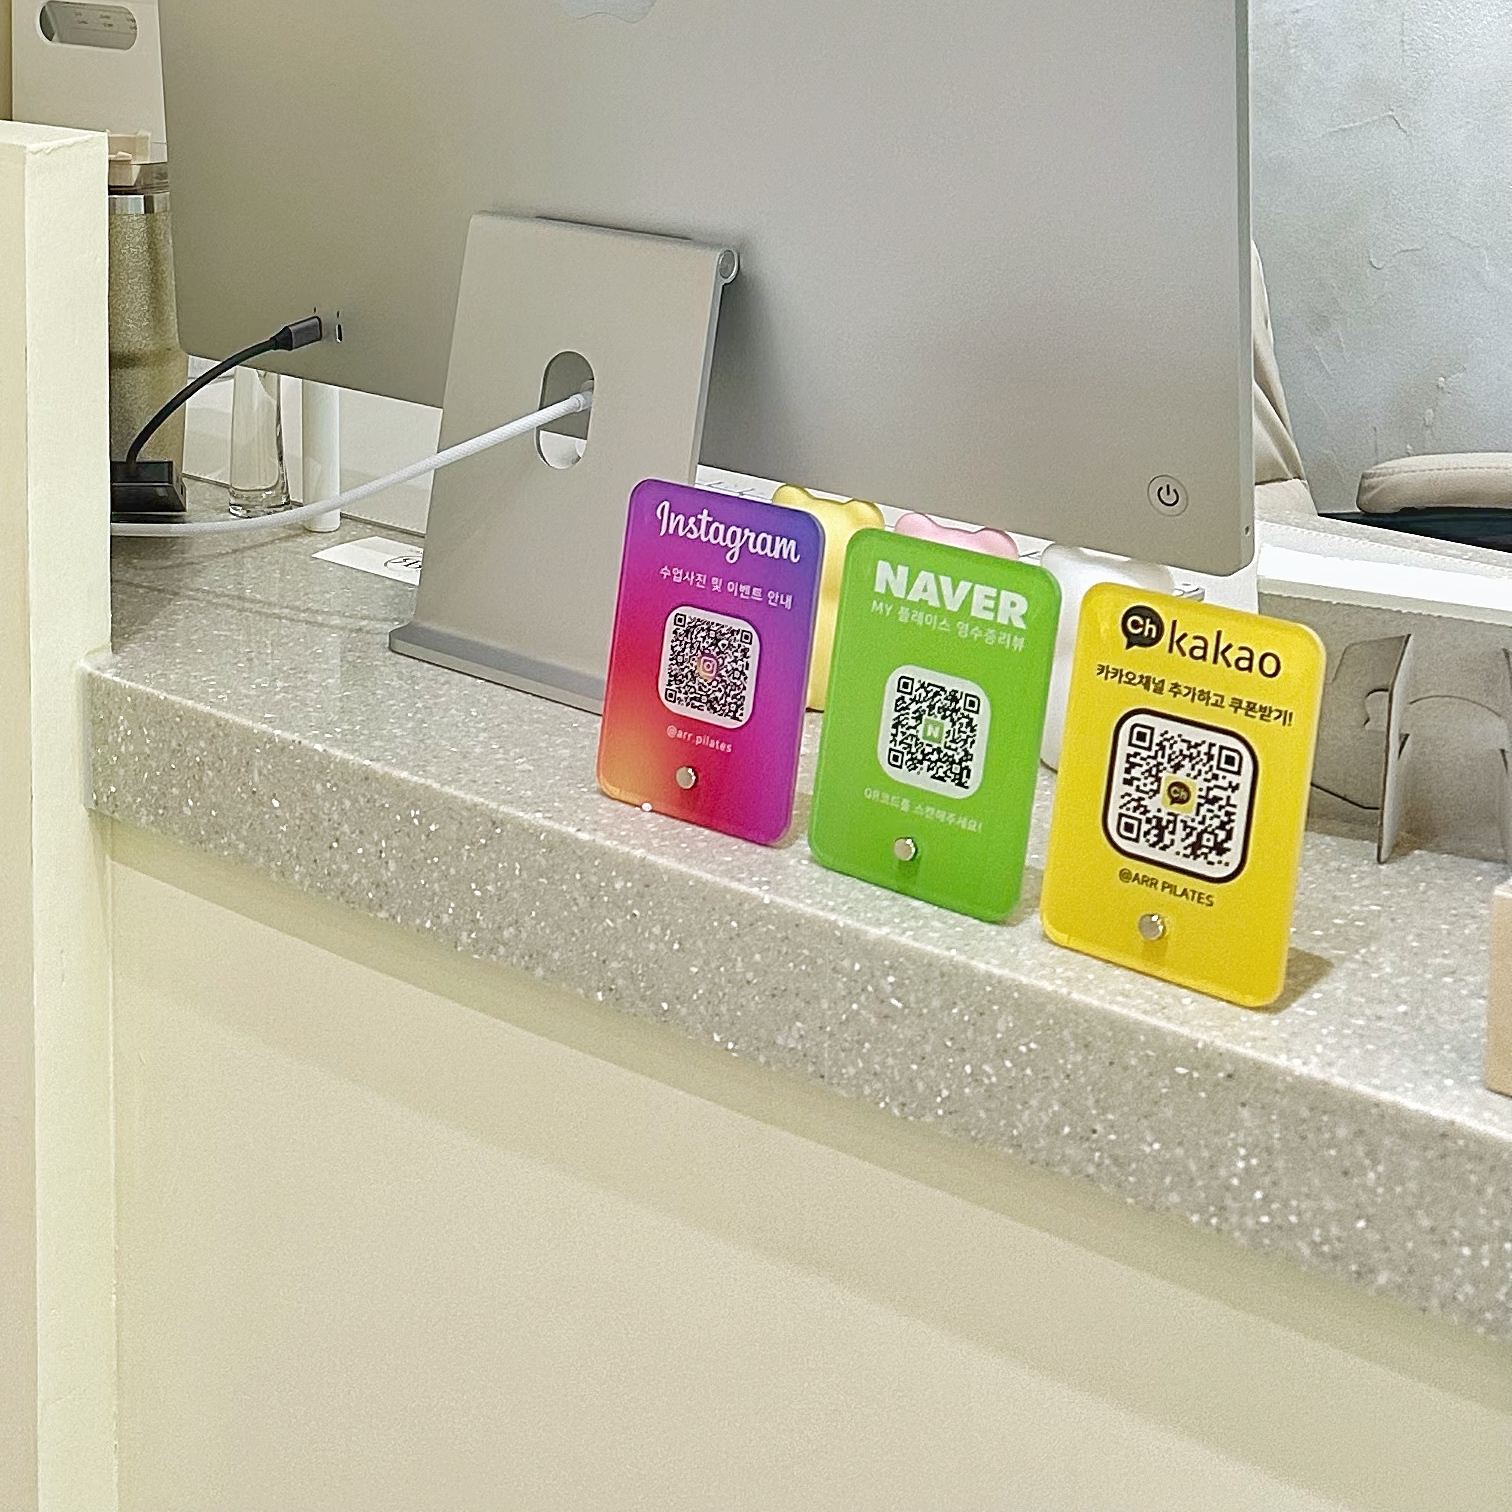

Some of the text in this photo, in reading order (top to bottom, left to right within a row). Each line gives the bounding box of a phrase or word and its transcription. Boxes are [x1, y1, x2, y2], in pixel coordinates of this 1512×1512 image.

[654, 499, 802, 565] Instagram
[659, 565, 794, 610] 수업사진 및 이벤트 안내
[873, 558, 1029, 630] NAVER
[870, 599, 1026, 653] MY 플레이스 영수증리뷰
[1125, 615, 1284, 680] Ch kakao
[1095, 663, 1295, 728] 카카오채널 추가하고 쿠폰받기!
[666, 724, 733, 753] @arr.pilates
[863, 786, 984, 834] QR코드를 스캔해주세요!
[1118, 867, 1215, 908] @ARR PILATES
